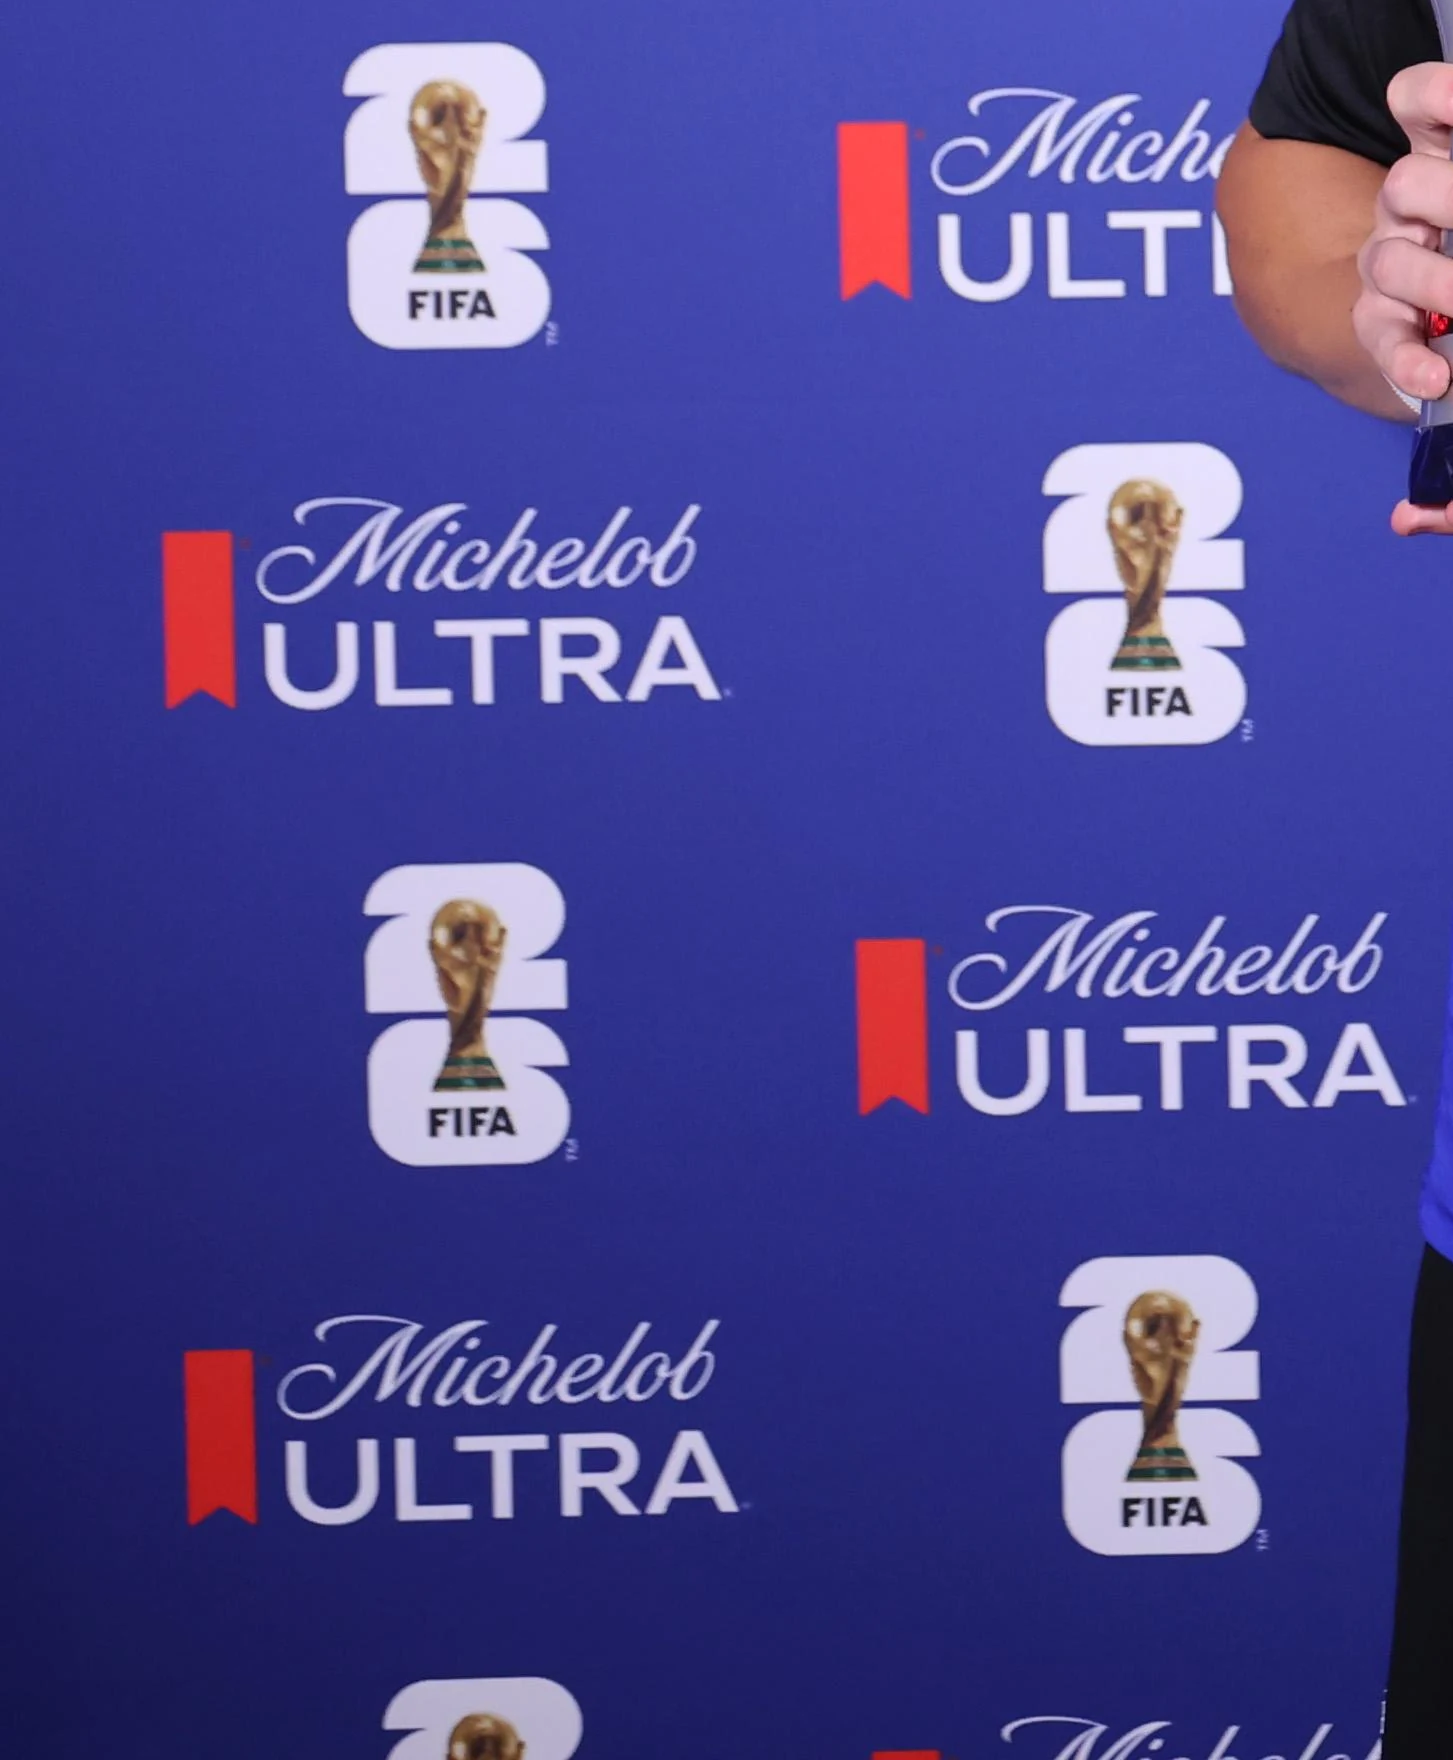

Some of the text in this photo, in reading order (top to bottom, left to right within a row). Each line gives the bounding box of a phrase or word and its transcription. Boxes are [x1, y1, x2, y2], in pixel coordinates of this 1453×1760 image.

[931, 87, 1236, 196] Mich
[938, 210, 1233, 303] ULT
[408, 289, 496, 320] FIFA
[257, 498, 700, 603] Michelob
[264, 616, 721, 710] ULTRA
[1106, 686, 1192, 717] FIFA
[949, 906, 1386, 1010] Michelob
[956, 1023, 1406, 1115] ULTRA
[429, 1106, 516, 1138] FIFA
[279, 1316, 718, 1420] Michelob
[286, 1430, 738, 1525] ULTRA
[1122, 1496, 1208, 1528] FIFA
